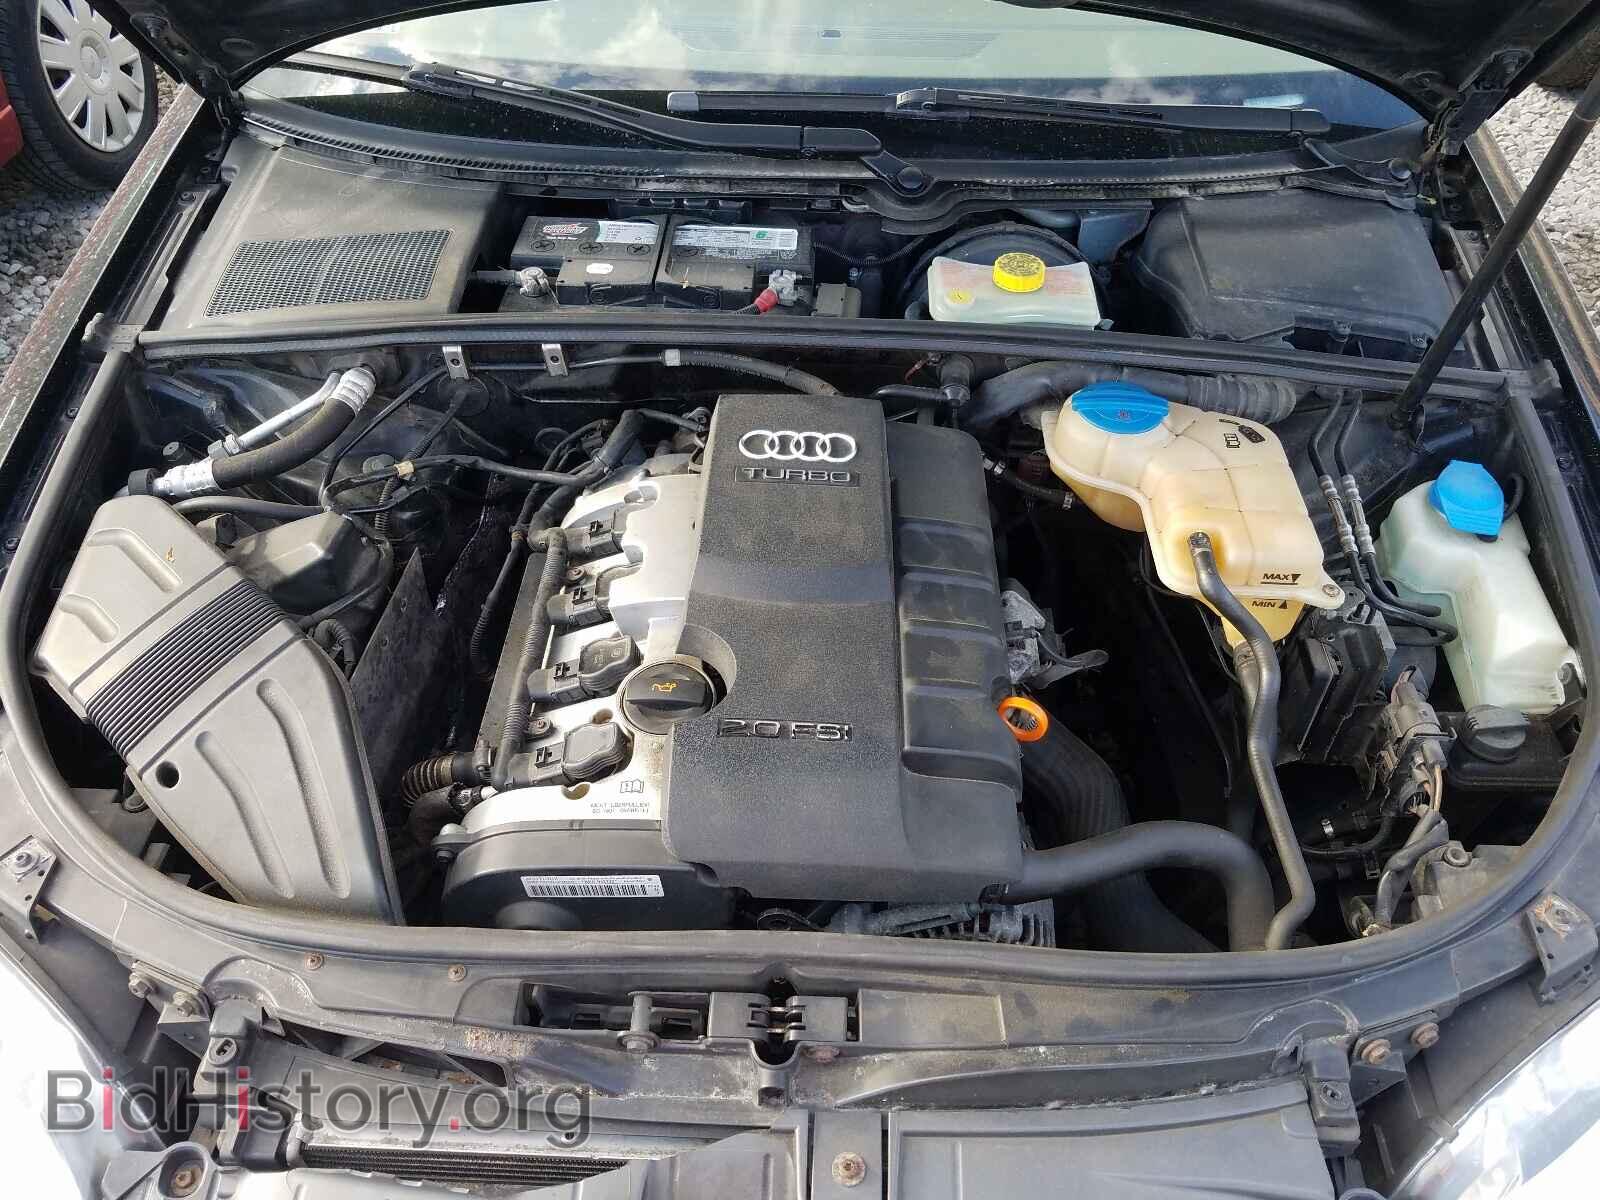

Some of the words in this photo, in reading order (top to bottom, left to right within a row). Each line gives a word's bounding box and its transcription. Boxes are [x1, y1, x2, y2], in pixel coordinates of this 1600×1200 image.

[743, 467, 850, 482] TURBO
[1262, 573, 1290, 581] MAX
[1251, 600, 1276, 608] MIN
[791, 721, 849, 739] FSI
